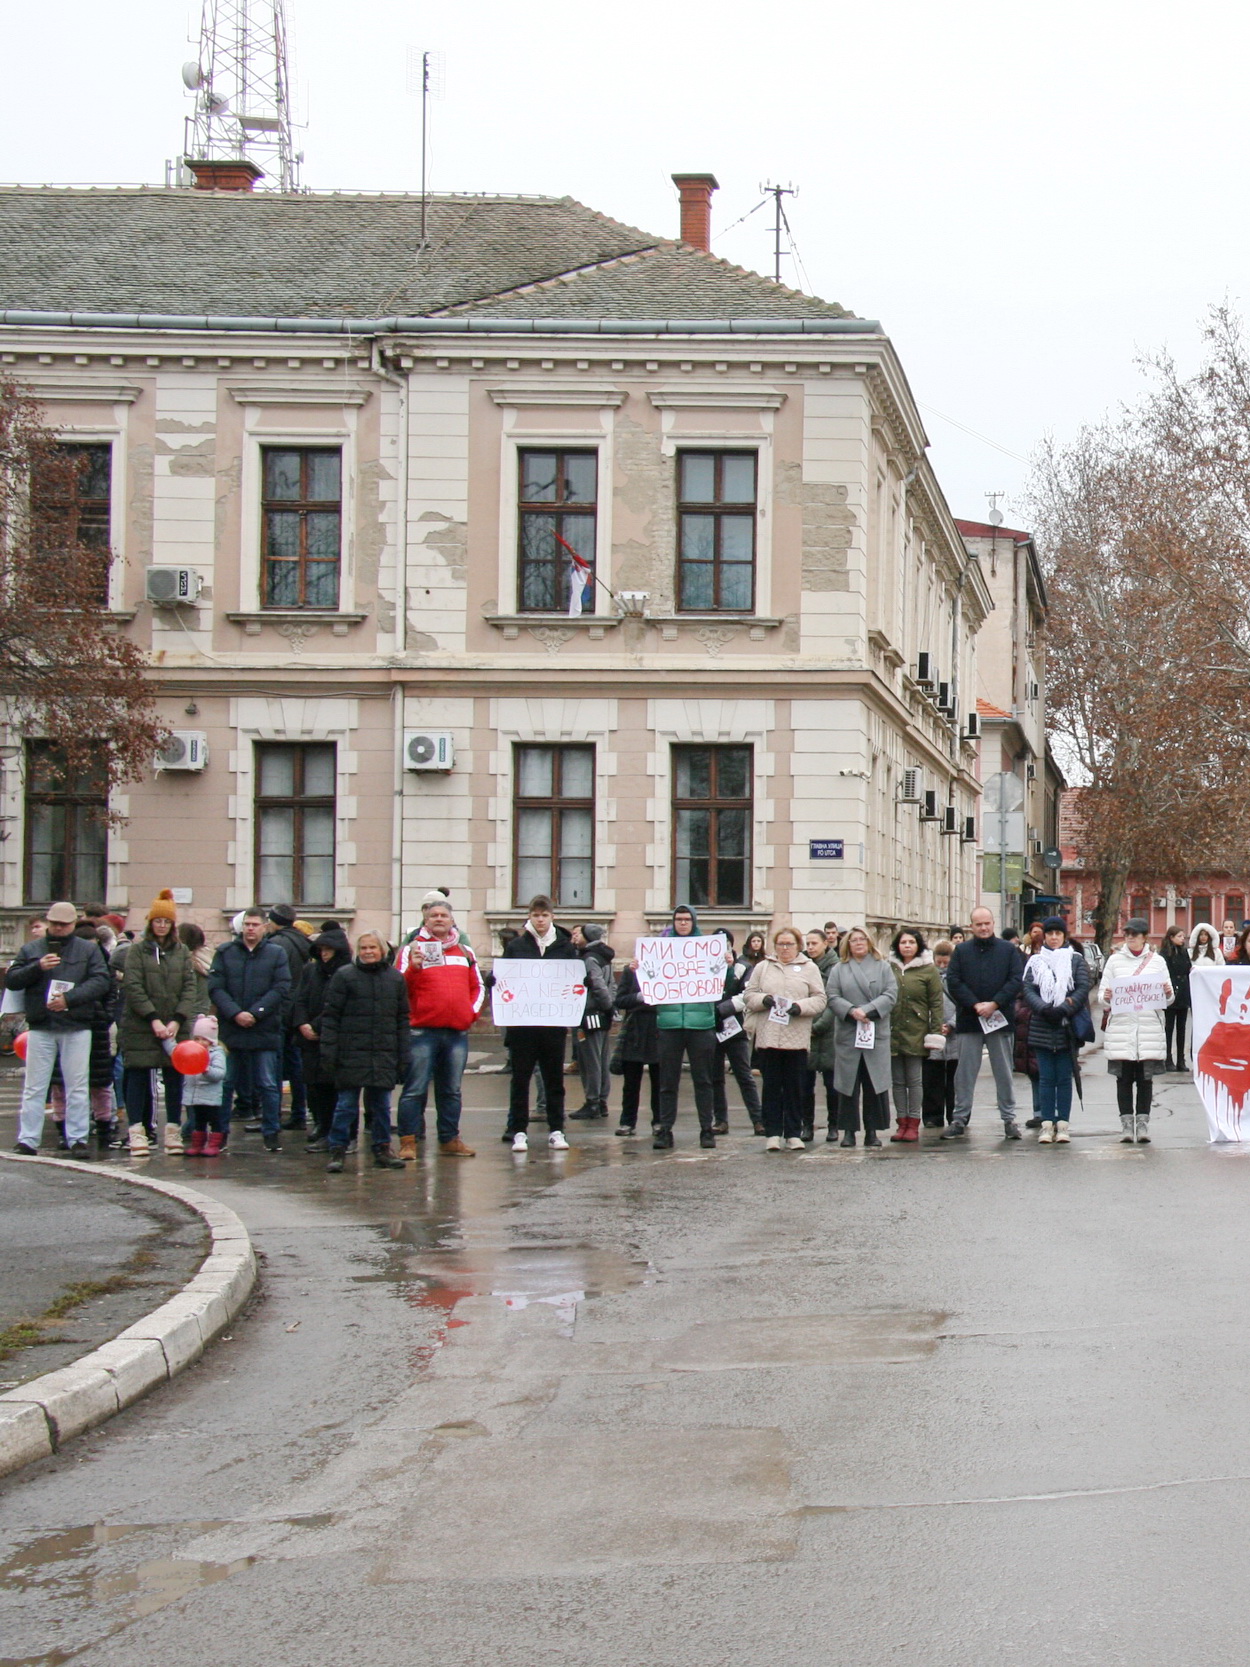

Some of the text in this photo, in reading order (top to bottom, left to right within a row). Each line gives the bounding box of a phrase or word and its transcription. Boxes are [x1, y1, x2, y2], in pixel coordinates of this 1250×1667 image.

[641, 939, 722, 961] МИ СМО
[662, 960, 706, 979] ОВДЕ
[516, 982, 561, 999] A NE
[495, 1002, 583, 1019] TRAGEDIJA
